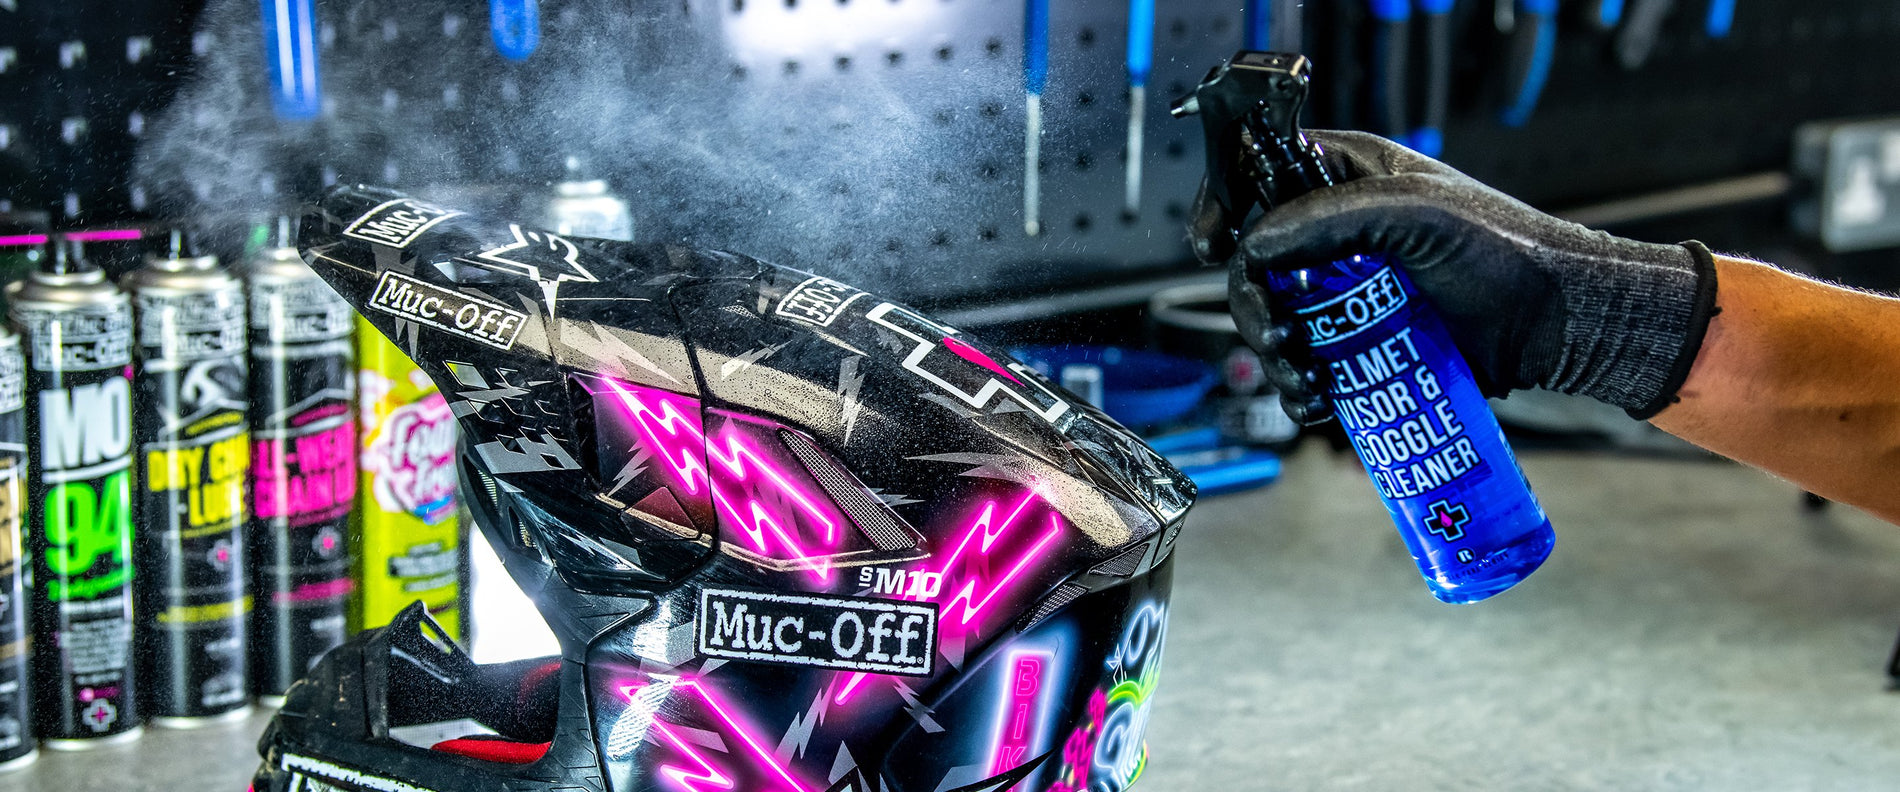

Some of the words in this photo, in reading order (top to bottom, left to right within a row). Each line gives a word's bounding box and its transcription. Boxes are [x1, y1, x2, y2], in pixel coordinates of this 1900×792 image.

[377, 276, 520, 342] Muc-Off
[1331, 327, 1420, 395] ELMET
[1334, 381, 1418, 431] VISOR
[1414, 365, 1442, 400] &
[1355, 401, 1462, 467] GOGGLE
[1374, 436, 1480, 499] CLEANER
[44, 470, 133, 576] 94
[710, 601, 923, 664] Muc-Off
[993, 659, 1040, 777] BIK
